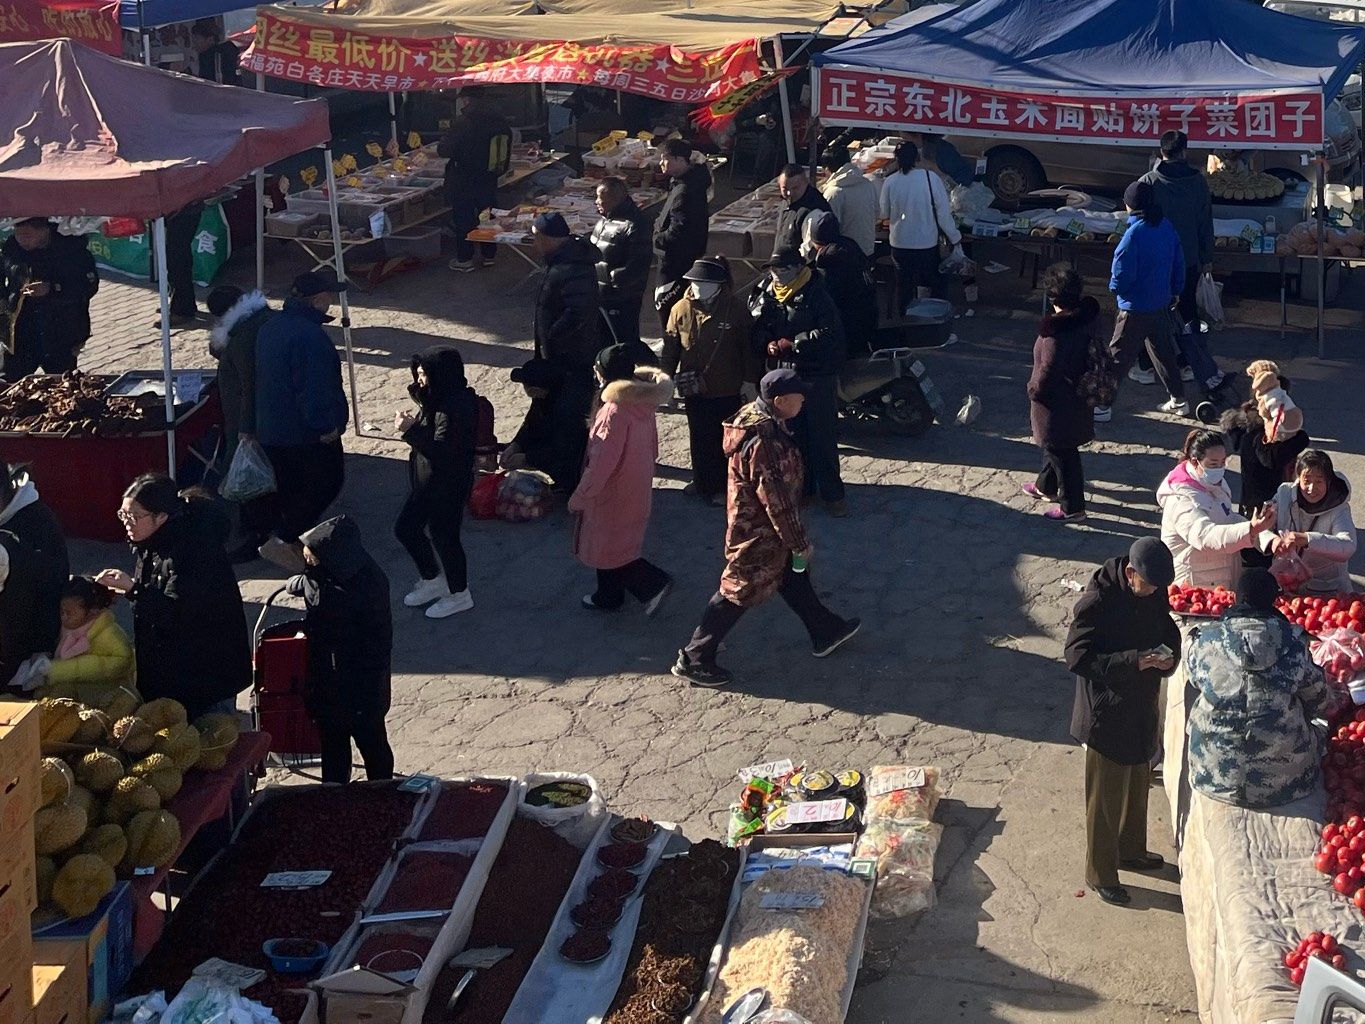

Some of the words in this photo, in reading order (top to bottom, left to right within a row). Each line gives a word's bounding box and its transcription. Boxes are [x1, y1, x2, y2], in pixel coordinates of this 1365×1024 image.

[240, 52, 415, 89] 福苑白各庄天天早市
[826, 77, 1317, 138] 正宗东北玉米面贴饼子菜团子
[194, 230, 218, 255] 食
[907, 769, 921, 781] 10
[804, 805, 816, 815] 2
